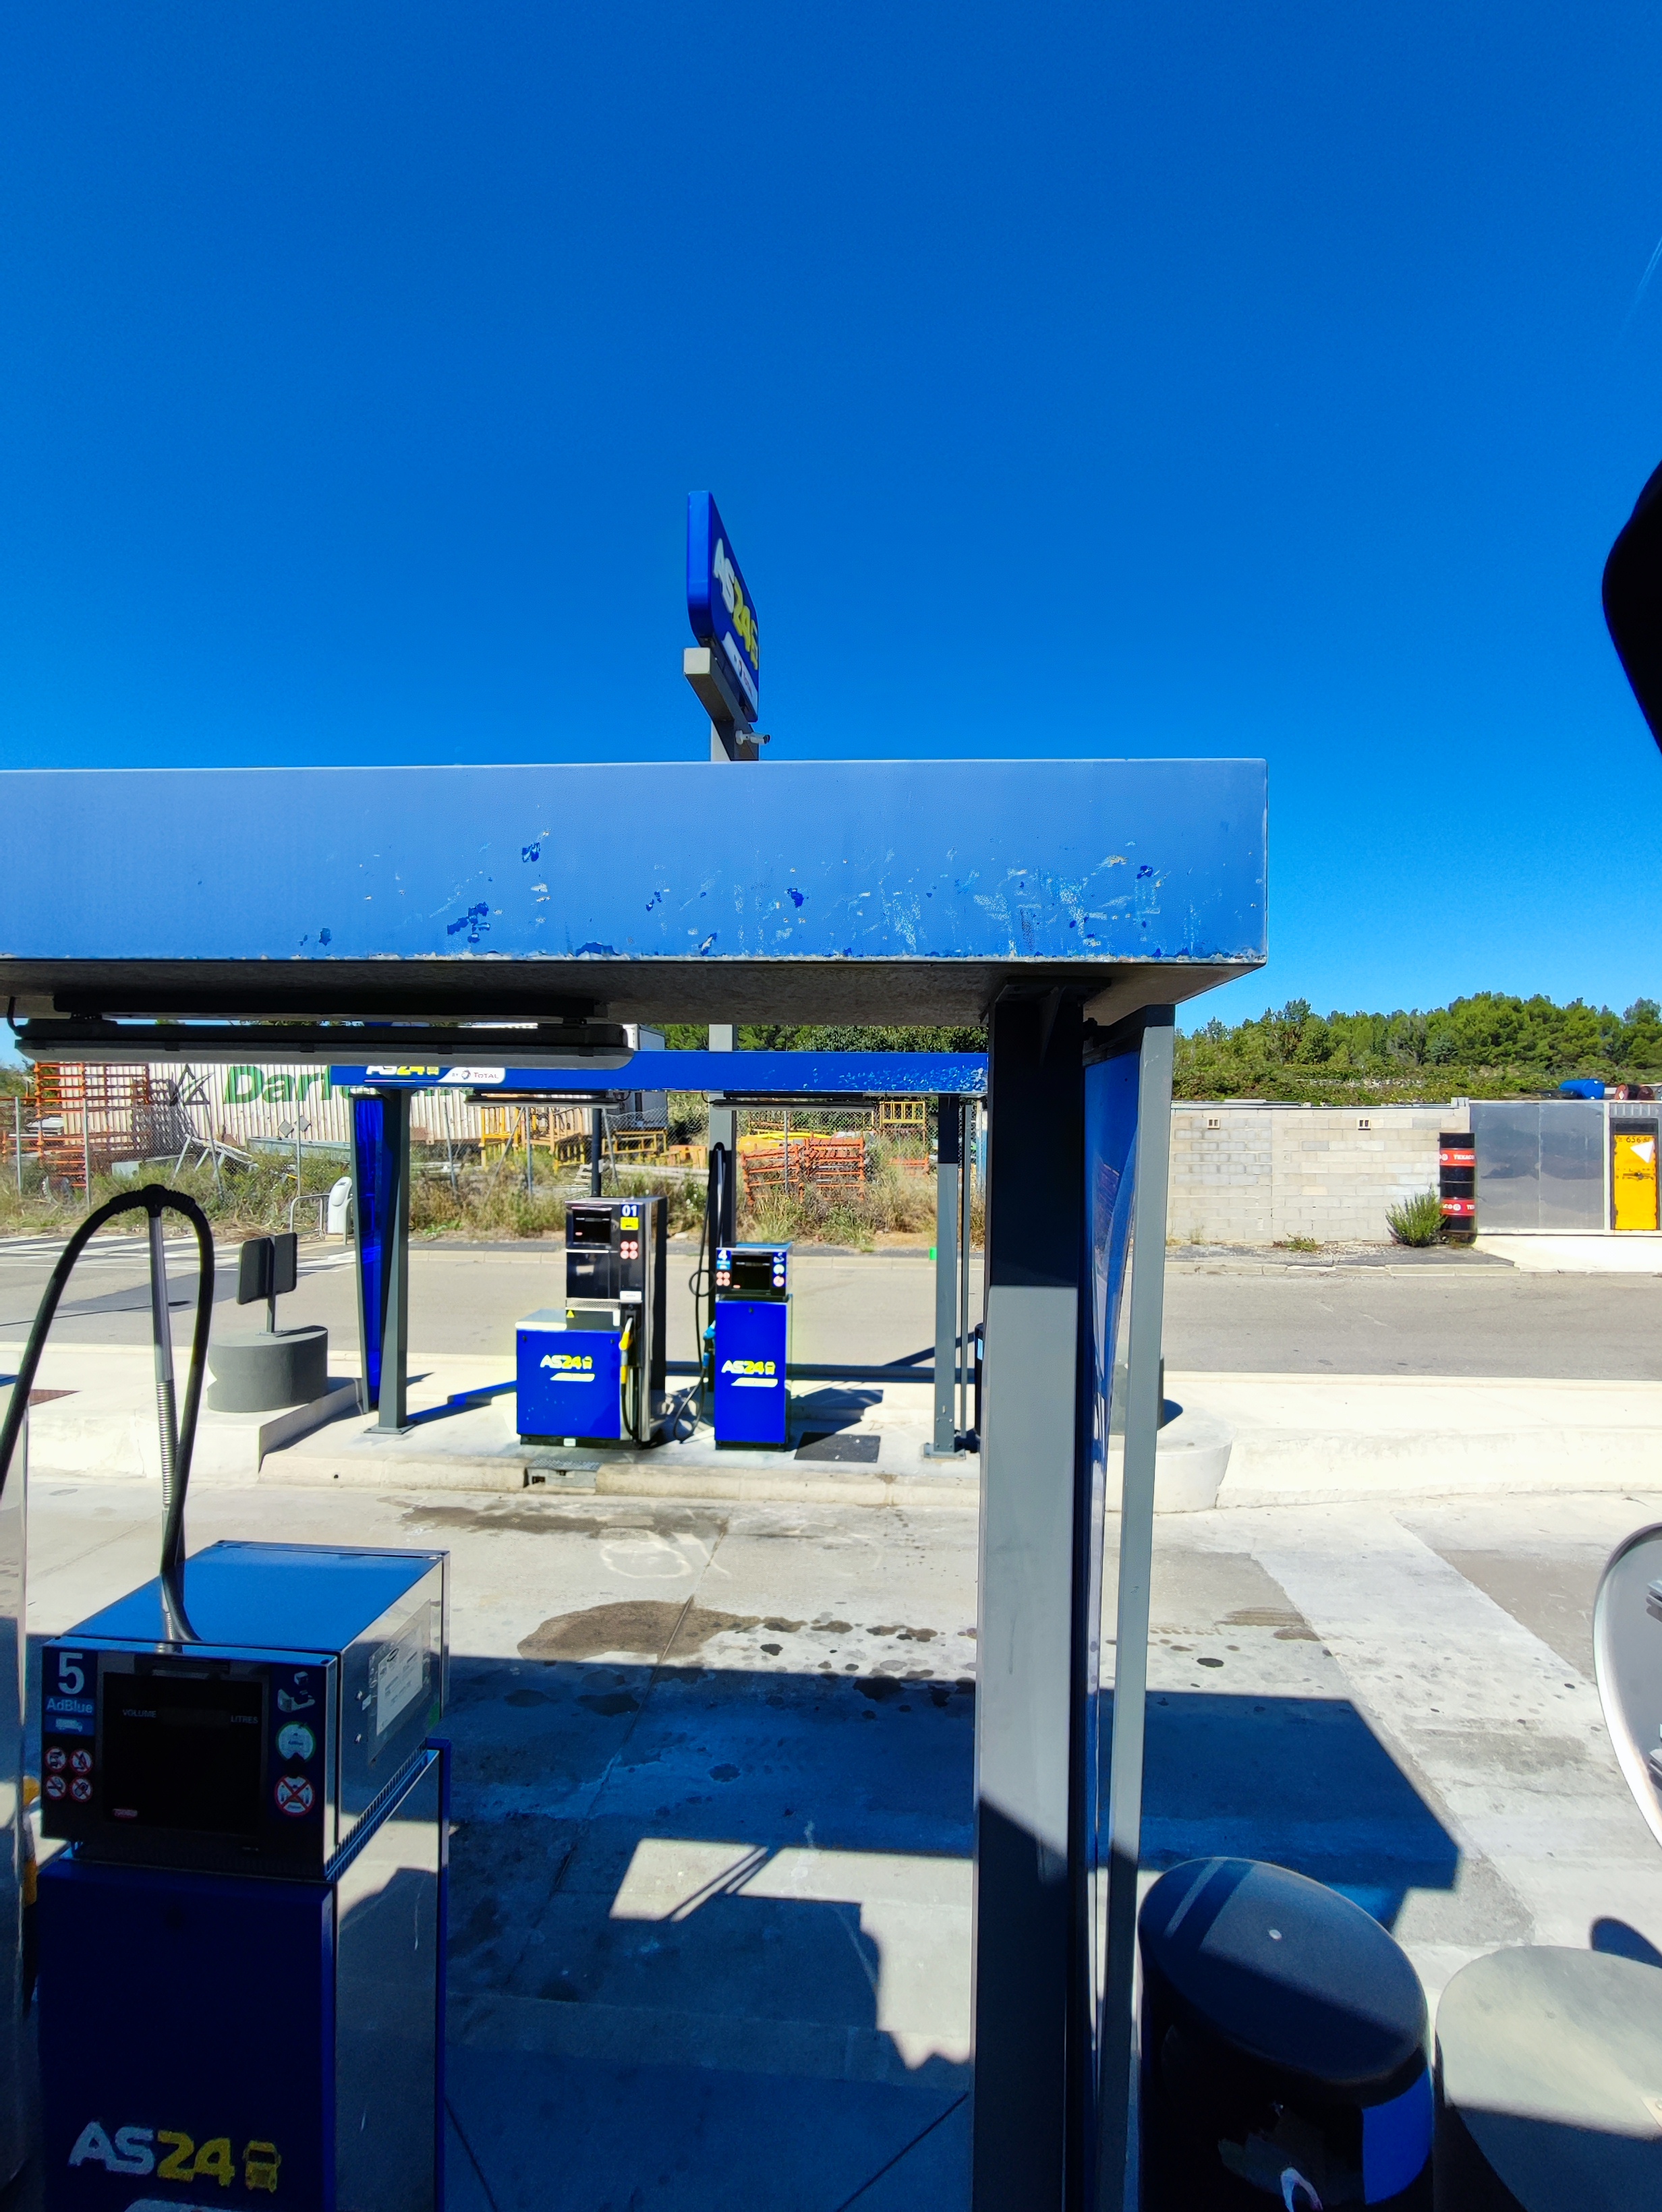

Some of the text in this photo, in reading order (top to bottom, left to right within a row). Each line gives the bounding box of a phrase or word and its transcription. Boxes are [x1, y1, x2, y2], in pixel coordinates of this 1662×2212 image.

[714, 538, 751, 652] AS24
[622, 1205, 637, 1217] 01
[718, 1250, 728, 1260] 4
[540, 1354, 581, 1369] AS24
[721, 1360, 764, 1374] AS24
[58, 1652, 85, 1694] 5
[46, 1698, 93, 1713] AdBlue
[122, 1709, 259, 1724] VOLUME LITRES
[67, 2121, 235, 2188] AS24
